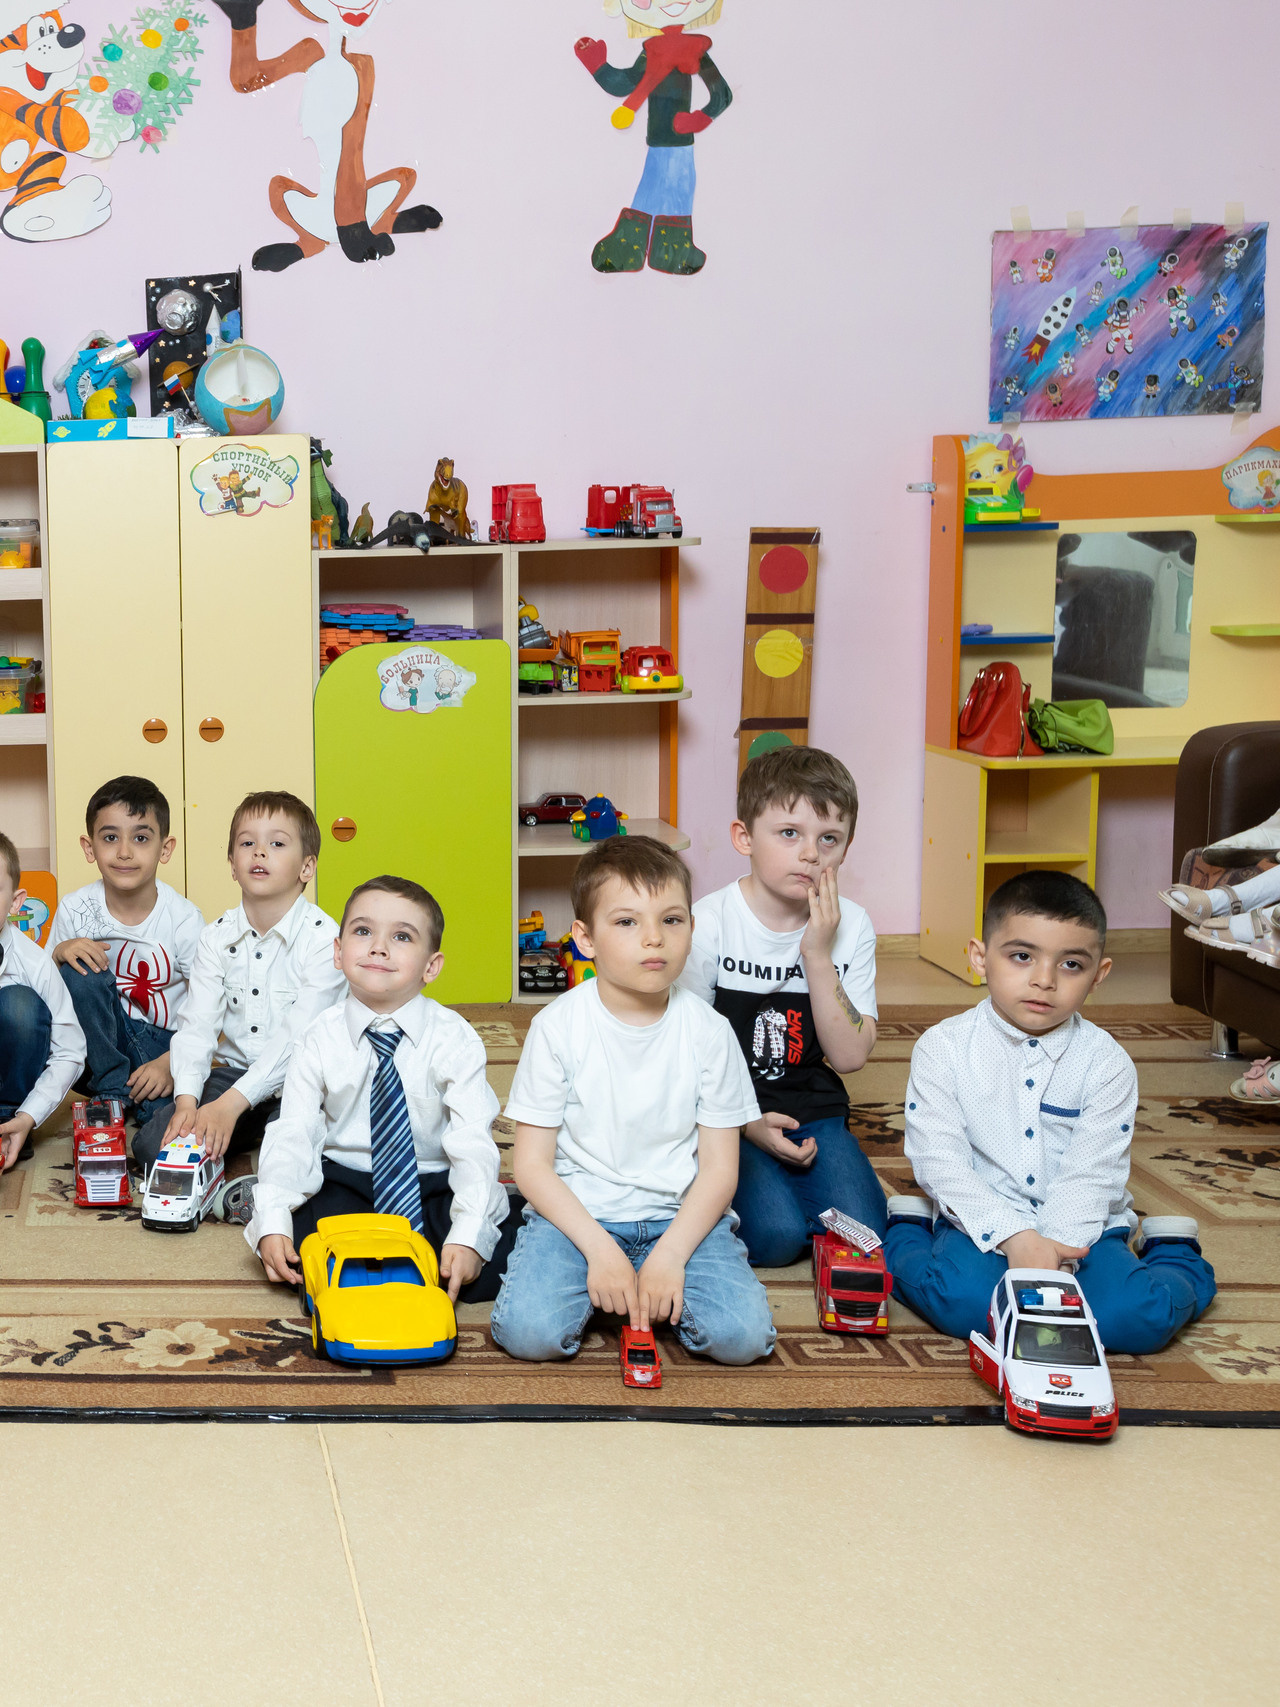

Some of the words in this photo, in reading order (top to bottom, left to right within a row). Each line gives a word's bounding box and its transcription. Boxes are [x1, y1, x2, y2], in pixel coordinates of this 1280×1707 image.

[212, 451, 293, 485] СПОРТИВНЫЙ
[231, 462, 272, 483] УГОЛОК
[1224, 459, 1280, 480] ПАРИКМАХ
[380, 653, 441, 684] БОЛЬНИЦА
[1045, 1389, 1085, 1397] POLICE
